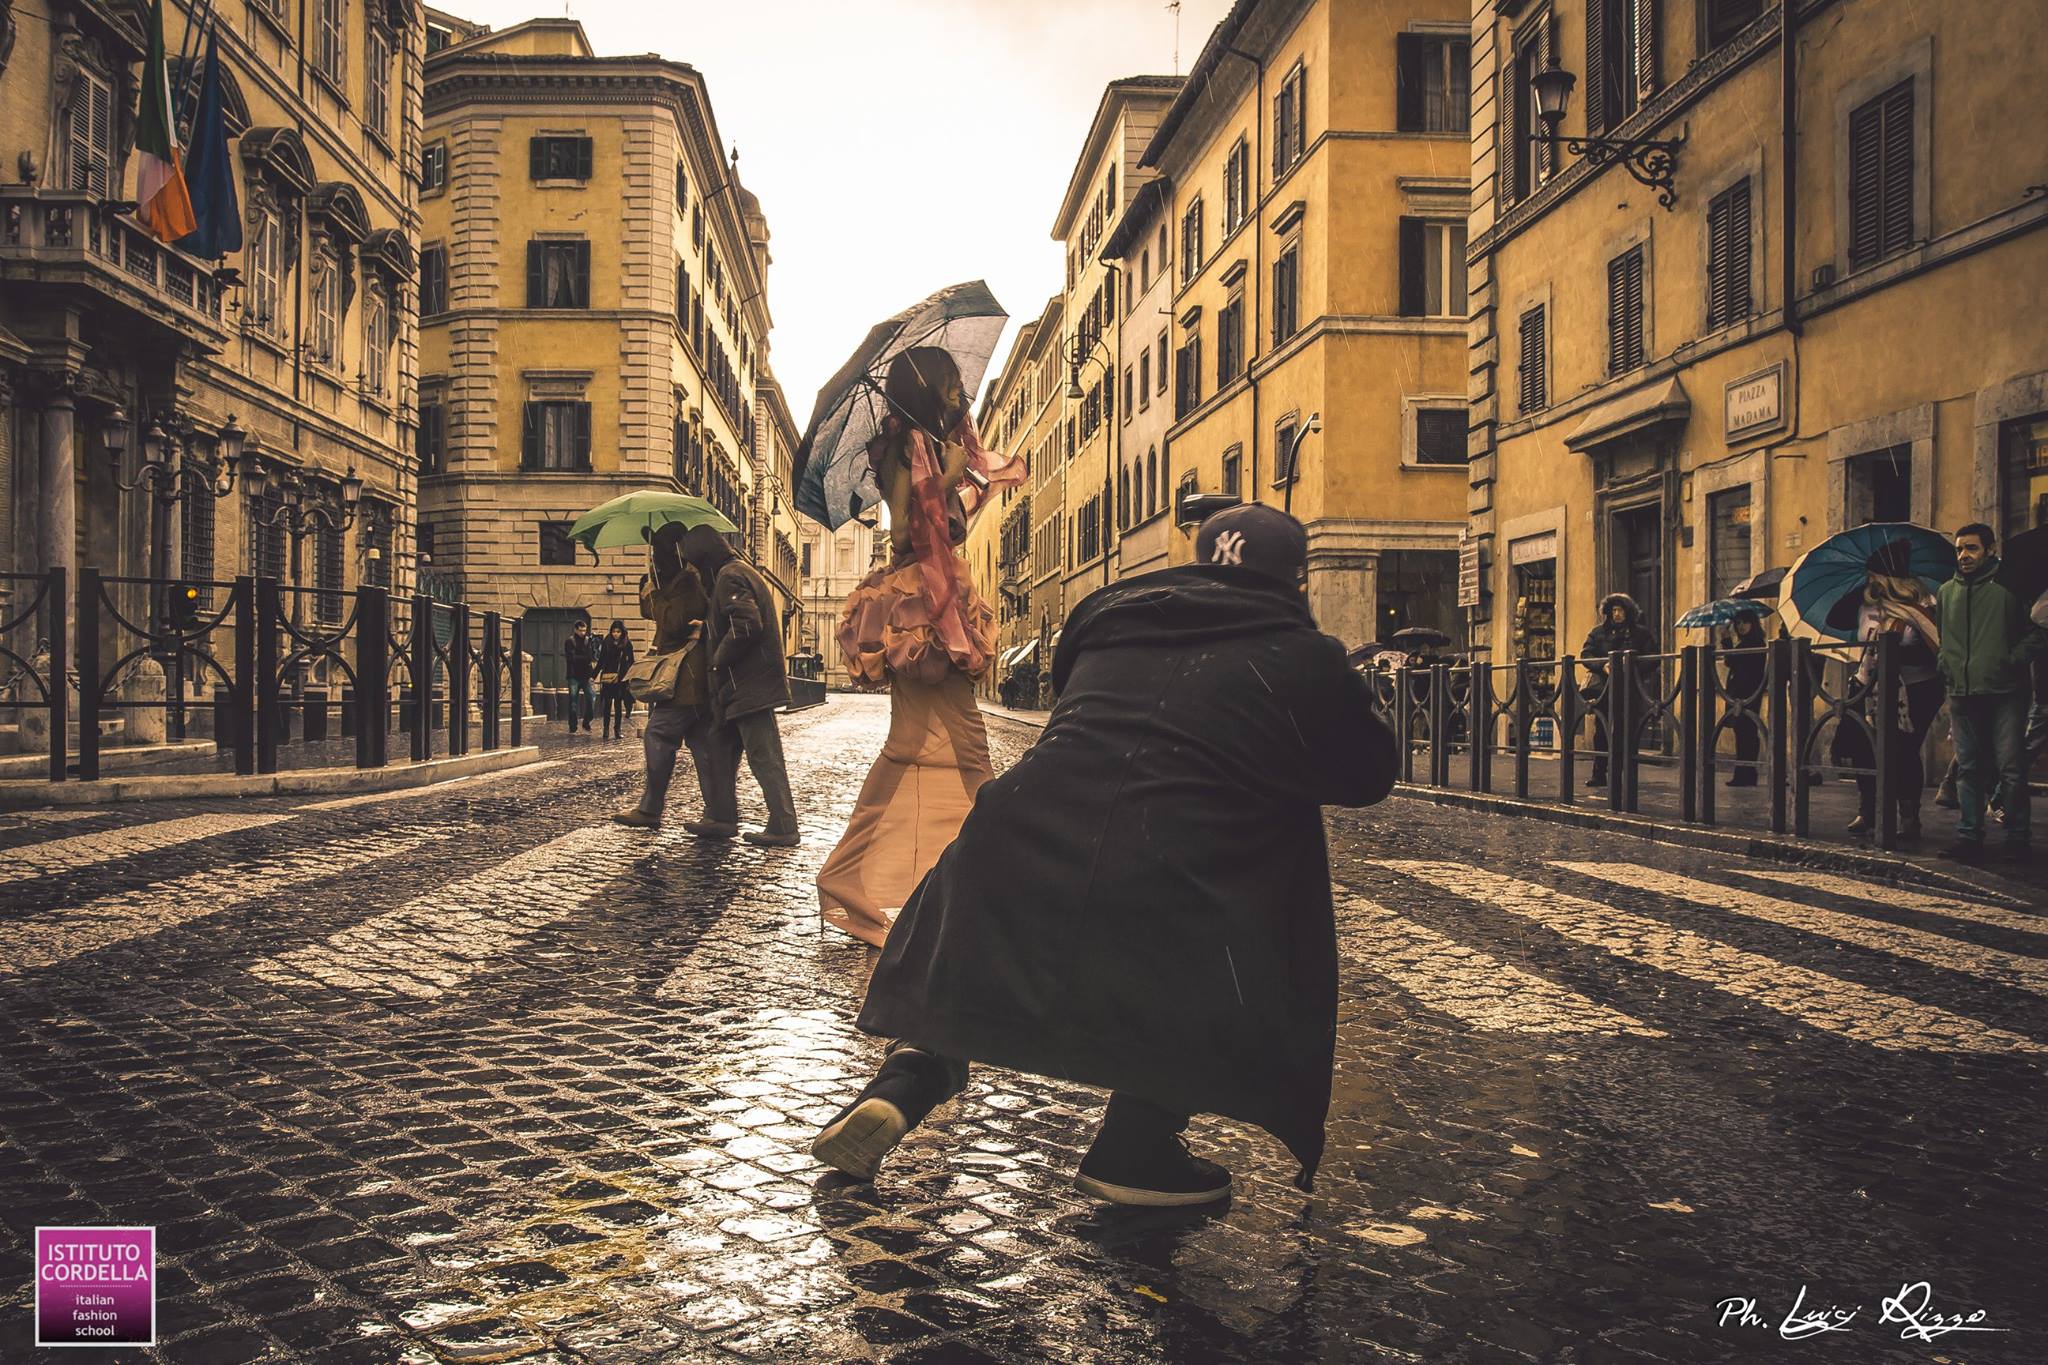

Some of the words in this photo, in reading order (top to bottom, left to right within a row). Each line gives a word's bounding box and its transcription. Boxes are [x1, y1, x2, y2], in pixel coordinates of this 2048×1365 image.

[1739, 385, 1766, 403] PIAZZA
[1733, 406, 1772, 427] MADAMA
[1211, 530, 1247, 565] NY
